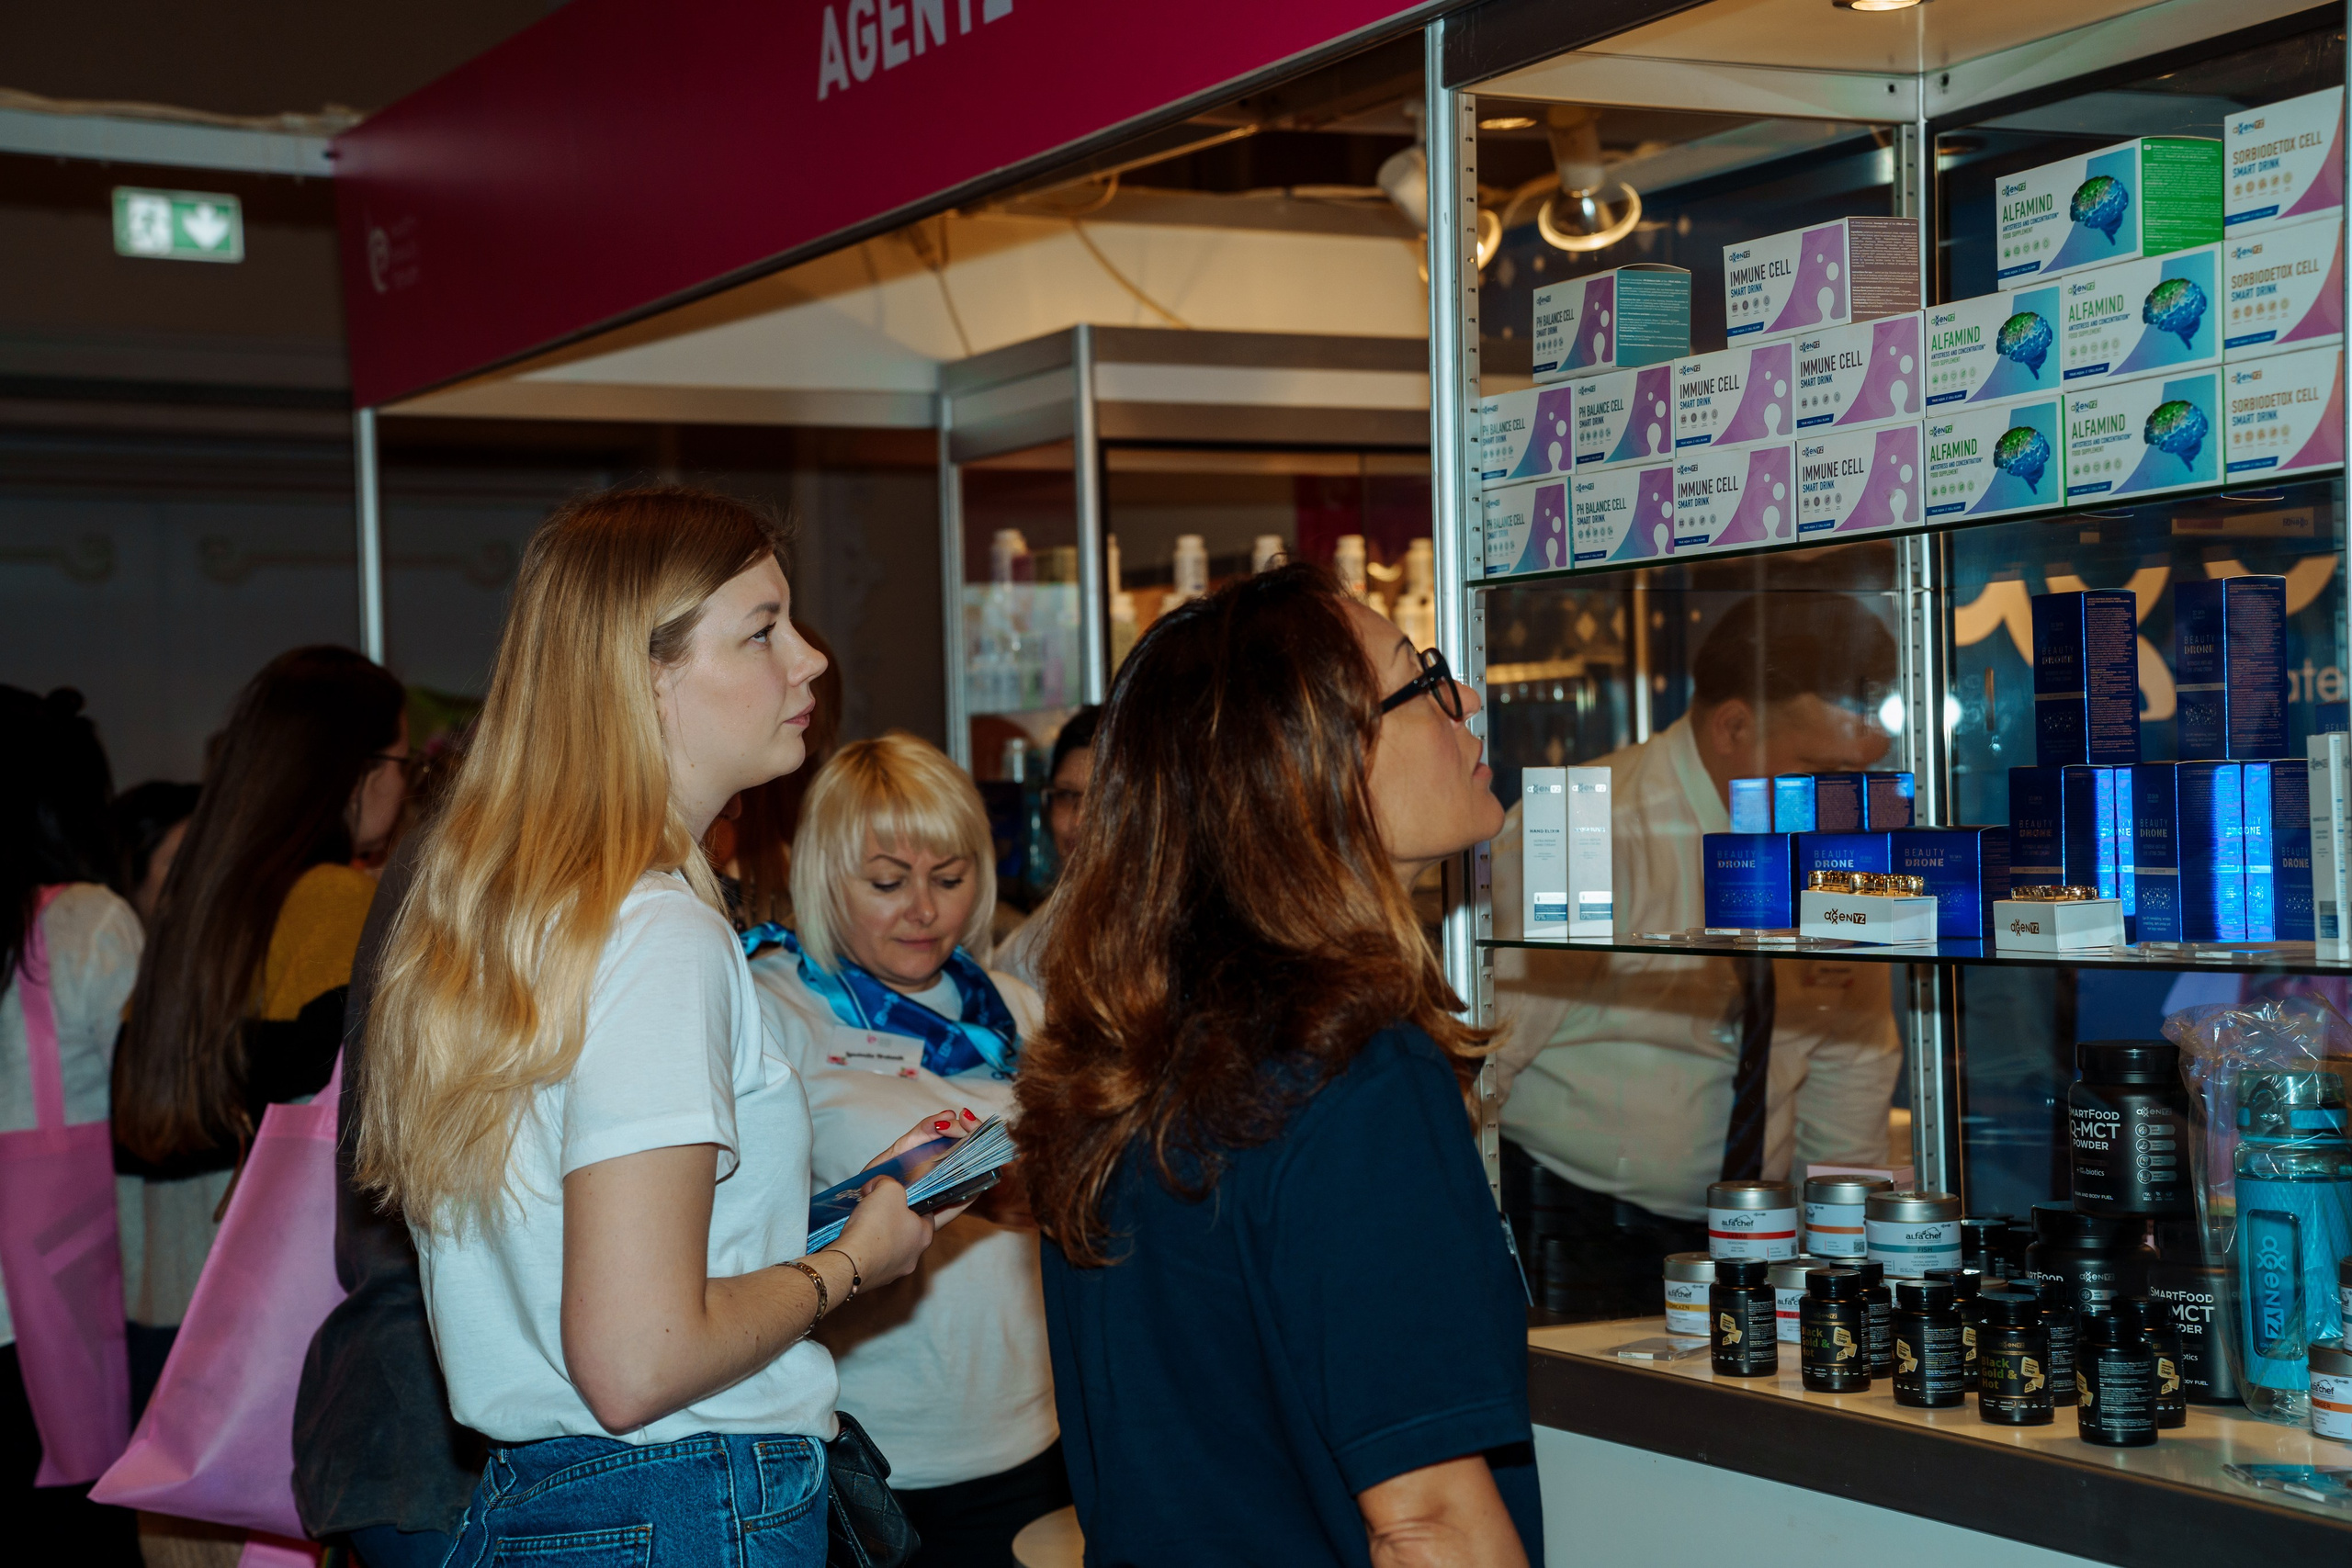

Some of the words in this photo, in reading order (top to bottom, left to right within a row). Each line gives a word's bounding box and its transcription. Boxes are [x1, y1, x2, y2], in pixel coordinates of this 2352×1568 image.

[818, 0, 1012, 102] AGEN
[2233, 137, 2296, 164] SORBIODETOX
[2299, 131, 2322, 149] CELL
[2233, 164, 2256, 178] SMART
[2258, 157, 2279, 173] DRINK
[2003, 193, 2052, 222] ALFAMIND
[2003, 221, 2021, 231] ANTISTRESS
[1730, 265, 1765, 287] IMMUNE
[1770, 259, 1791, 277] CELL
[2232, 265, 2292, 288] SORBIODETOX
[2296, 259, 2319, 276] CELL
[1731, 286, 1747, 298] SMART
[1747, 283, 1762, 294] DRINK
[2232, 288, 2254, 302] SMART
[2256, 284, 2277, 297] DRINK
[2069, 295, 2123, 322] ALFAMIND
[1536, 314, 1542, 327] PH
[1544, 311, 1562, 327] BALANCE
[1564, 309, 1574, 321] CELL
[2068, 321, 2089, 331] ANTISTRESS
[1931, 326, 1980, 352] ALFAMIND
[1931, 351, 1950, 359] ANTISTRESS
[1801, 355, 1836, 377] IMMUNE
[1839, 350, 1862, 369] CELL
[1680, 378, 1714, 399] IMMUNE
[1718, 375, 1739, 392] CELL
[1801, 377, 1816, 389] SMART
[1817, 374, 1833, 385] DRINK
[1680, 399, 1695, 410] SMART
[1697, 397, 1711, 407] DRINK
[2233, 391, 2293, 413] SORBIODETOX
[2297, 388, 2319, 402] CELL
[1579, 407, 1586, 418] PH
[1587, 402, 1610, 416] BALANCE
[1611, 399, 1623, 412] CELL
[1579, 419, 1591, 428] SMART
[1592, 416, 1604, 425] DRINK
[2233, 414, 2255, 426] SMART
[2257, 411, 2278, 423] DRINK
[1483, 426, 1489, 435] PH
[1490, 422, 1512, 434] BALANCE
[1513, 418, 1525, 430] CELL
[2072, 414, 2125, 439] ALFAMIND
[2072, 440, 2092, 448] ANTISTRESS
[1930, 439, 1977, 462] ALFAMIND
[1803, 461, 1838, 481] IMMUNE
[1842, 457, 1864, 476] CELL
[1930, 462, 1948, 470] ANTISTRESS
[1679, 479, 1713, 498] IMMUNE
[1716, 476, 1738, 492] CELL
[1803, 482, 1818, 493] SMART
[1820, 480, 1835, 491] DRINK
[1577, 503, 1584, 515] PH
[1586, 500, 1611, 514] BALANCE
[1612, 498, 1626, 510] CELL
[1678, 499, 1693, 509] SMART
[1695, 497, 1709, 507] DRINK
[1577, 516, 1590, 525] SMART
[1592, 514, 1605, 523] DRINK
[2184, 635, 2215, 644] BEAUTY
[2185, 645, 2214, 654] DRONE
[2140, 818, 2167, 827] BEAUTY
[2141, 829, 2167, 838] DRONE
[1717, 850, 1756, 859] BEAUTY
[1815, 850, 1855, 858] BEAUTY
[1905, 848, 1945, 857] BEAUTY
[1717, 860, 1756, 868] DRONE
[1815, 859, 1854, 868] DRONE
[1905, 858, 1944, 867] DRONE
[2283, 859, 2309, 868] DRONE
[2073, 1139, 2109, 1150] POWDER
[1802, 1325, 1823, 1337] Black
[1802, 1337, 1818, 1348] Gold
[1822, 1339, 1830, 1348] &
[1802, 1347, 1815, 1358] Hot
[1981, 1356, 2009, 1368] Black
[1982, 1368, 2004, 1379] Gold
[2007, 1370, 2018, 1380] &
[1982, 1378, 1999, 1389] Hot
